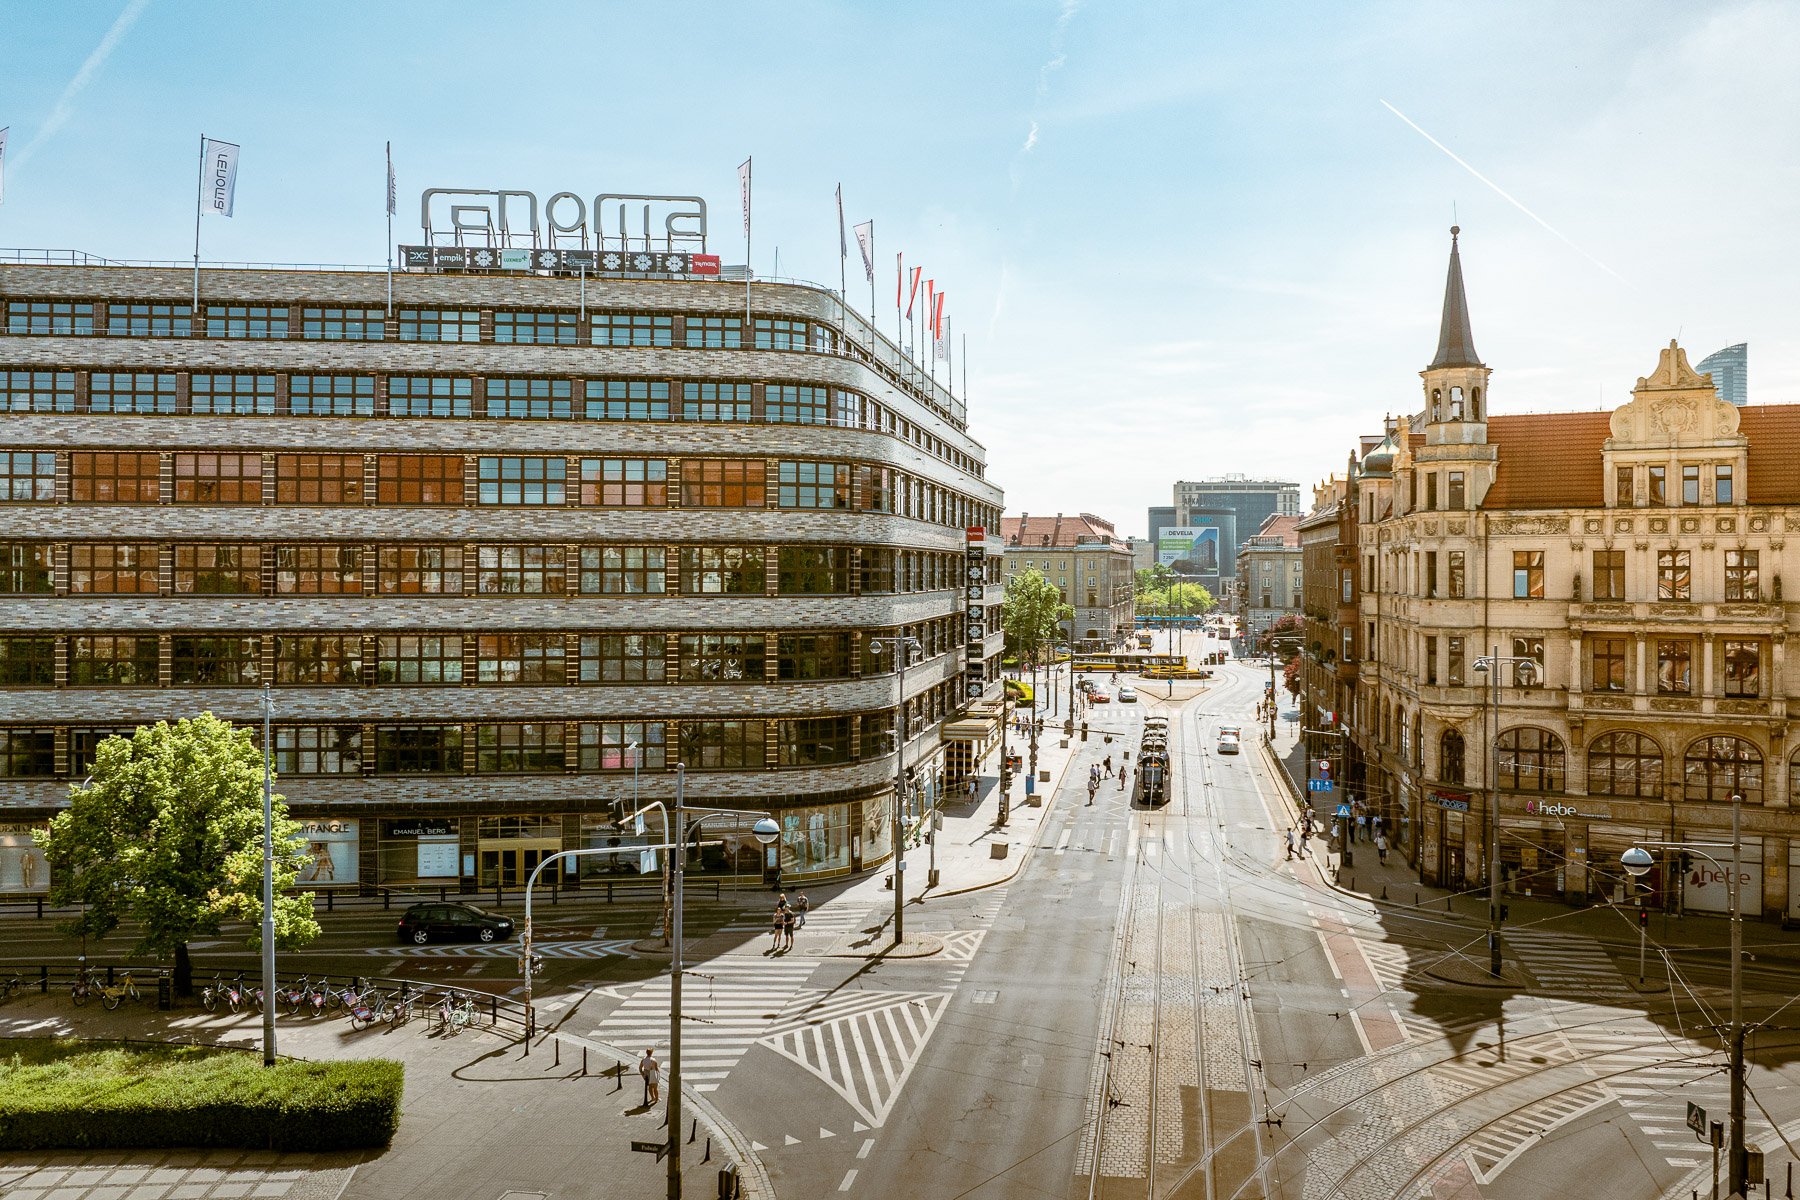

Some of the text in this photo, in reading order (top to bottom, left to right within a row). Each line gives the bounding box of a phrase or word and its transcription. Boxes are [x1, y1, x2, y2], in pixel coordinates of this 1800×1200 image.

[421, 187, 707, 237] renoma
[439, 253, 464, 263] empik
[1539, 801, 1577, 816] hebe
